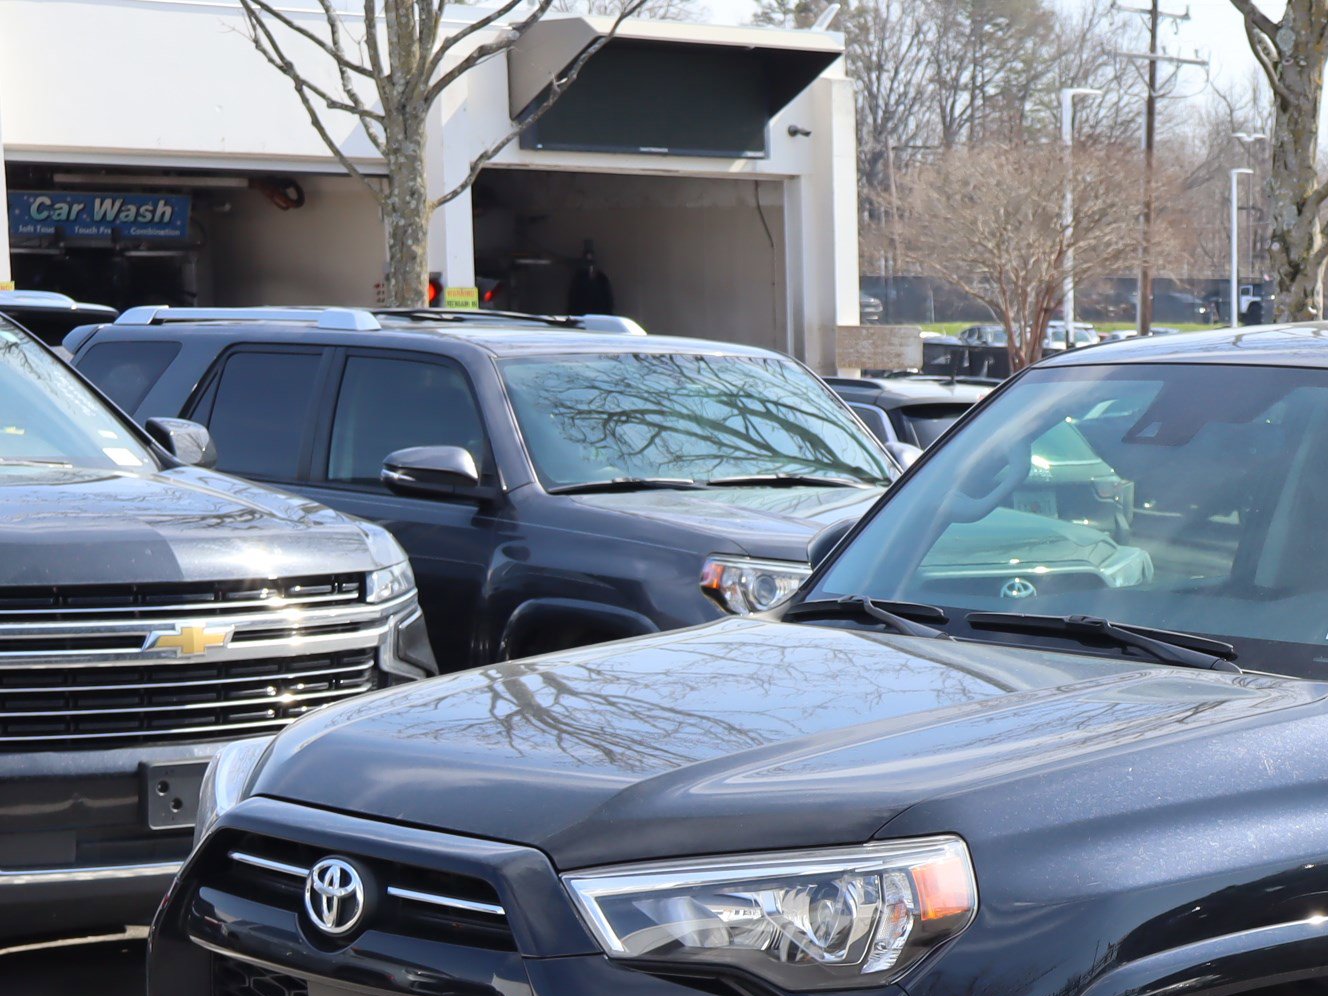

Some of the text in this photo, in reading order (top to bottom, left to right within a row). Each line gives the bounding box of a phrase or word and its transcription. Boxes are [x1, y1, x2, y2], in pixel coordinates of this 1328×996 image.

[30, 196, 173, 223] Car Wash
[36, 225, 55, 234] Touc
